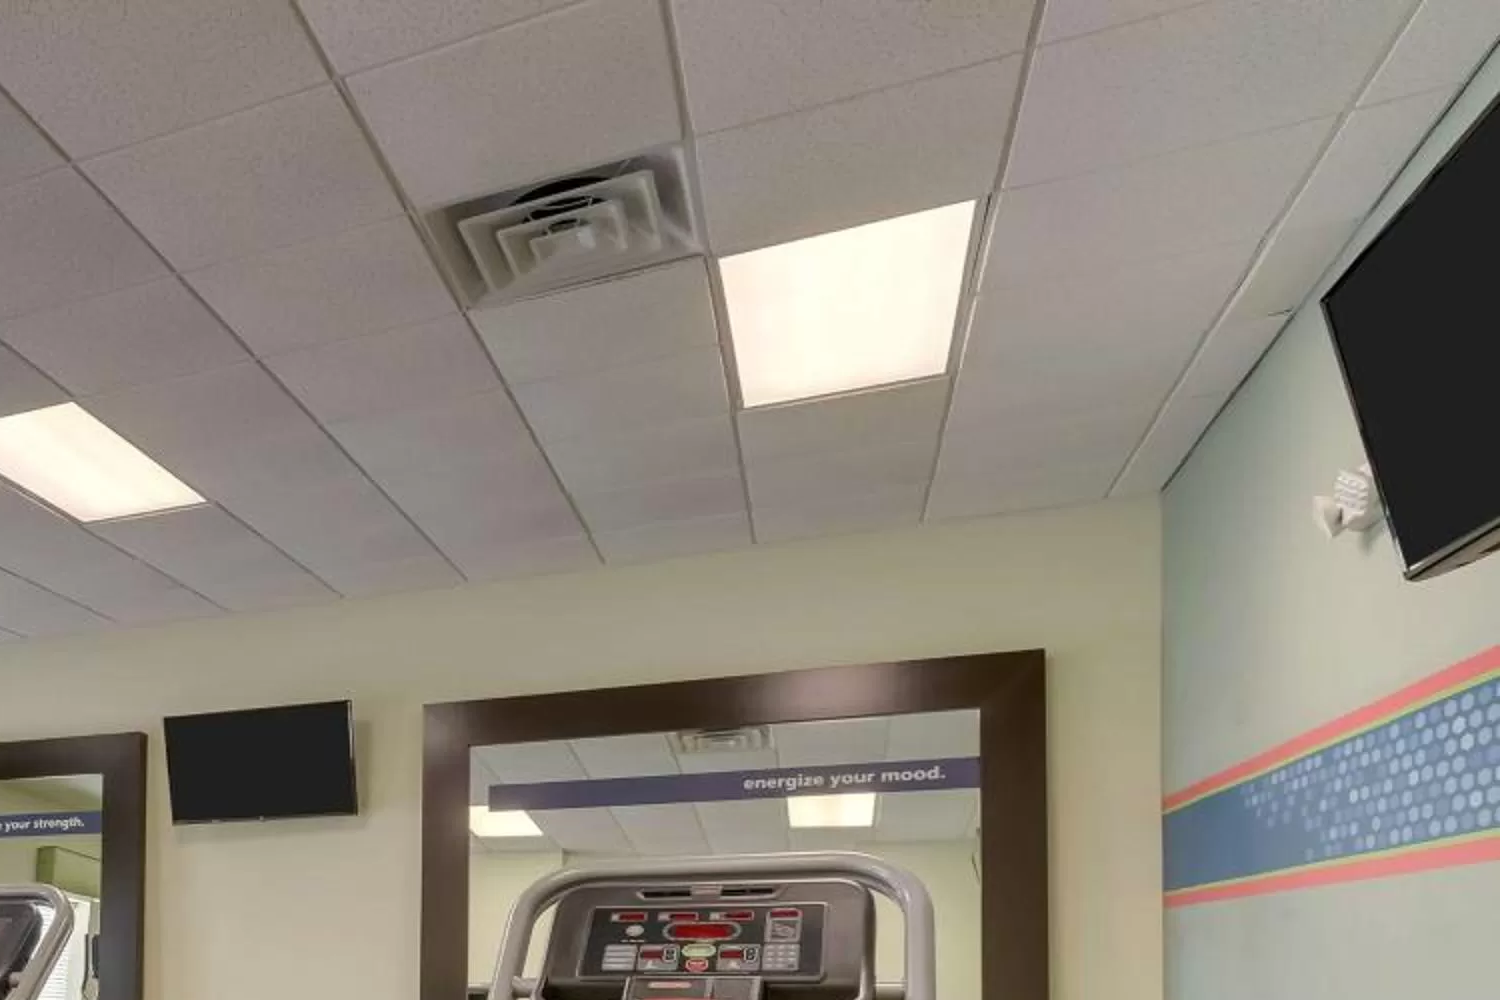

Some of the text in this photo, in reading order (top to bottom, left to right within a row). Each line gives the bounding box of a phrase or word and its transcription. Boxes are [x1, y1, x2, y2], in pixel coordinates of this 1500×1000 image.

[743, 766, 946, 790] energize your mood.
[5, 820, 31, 833] your
[33, 816, 85, 831] strength.
